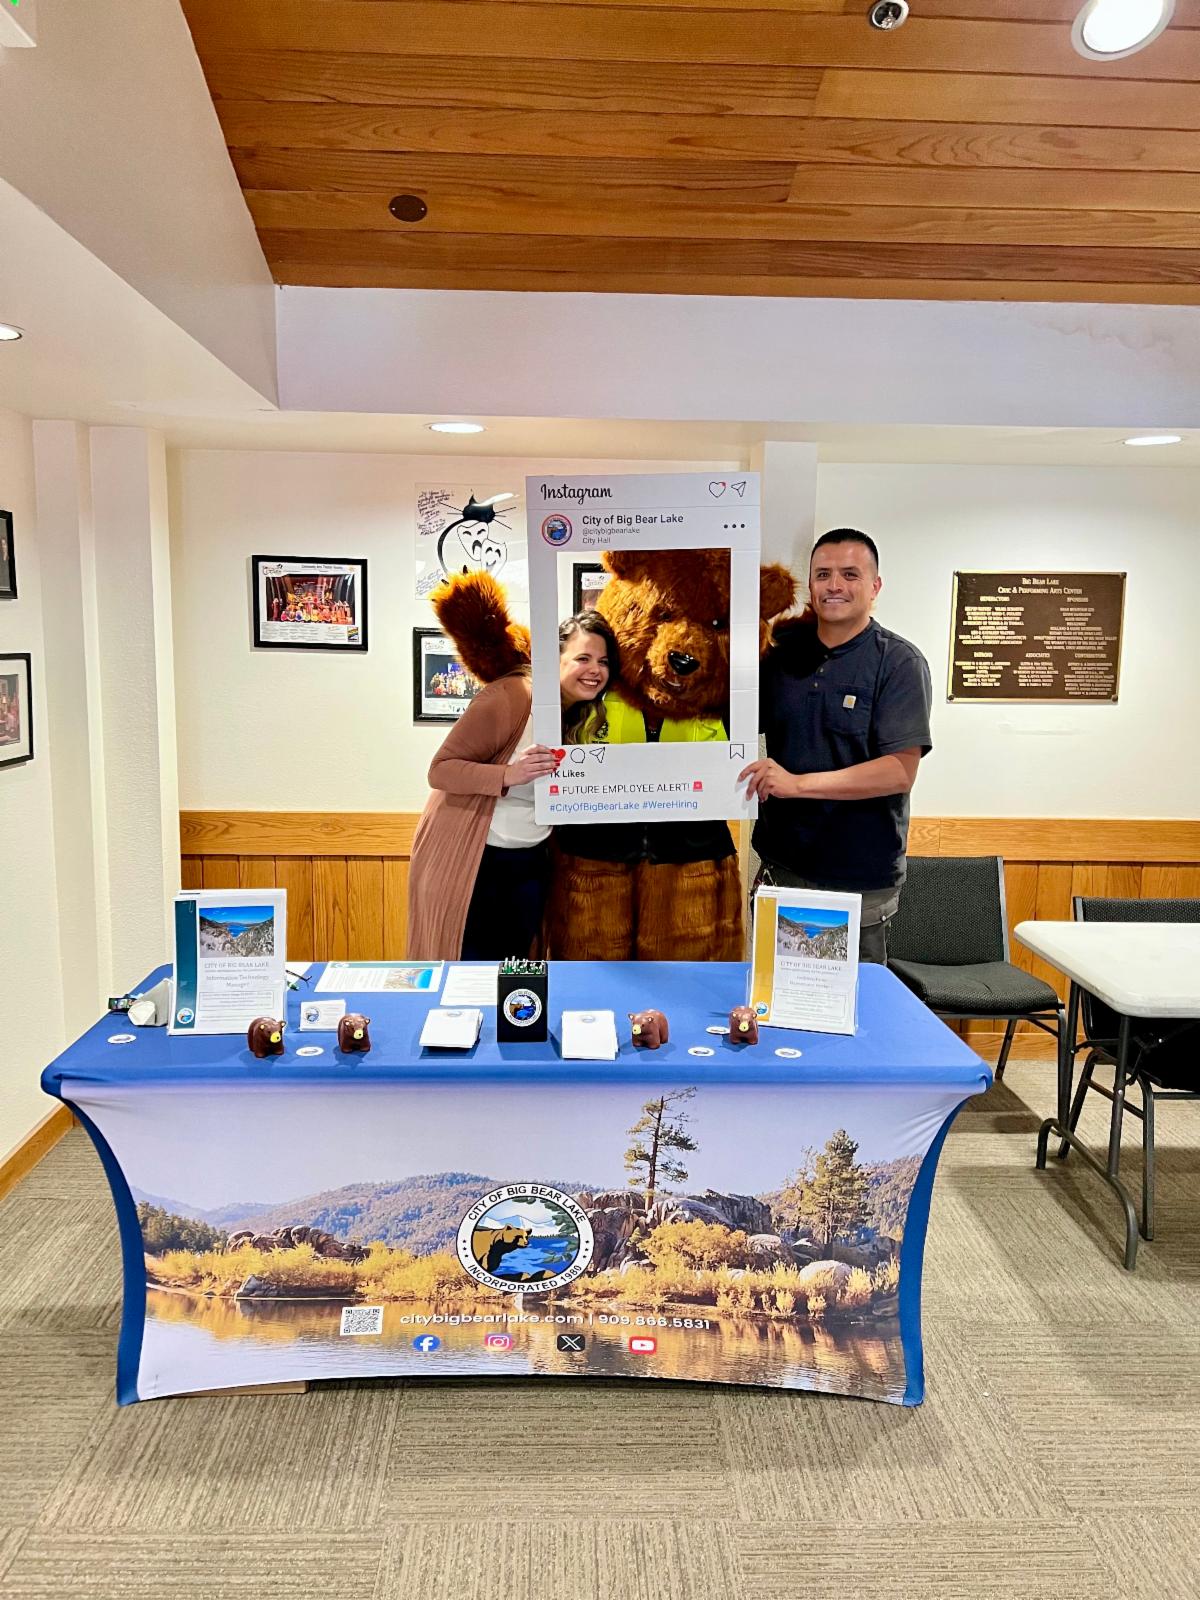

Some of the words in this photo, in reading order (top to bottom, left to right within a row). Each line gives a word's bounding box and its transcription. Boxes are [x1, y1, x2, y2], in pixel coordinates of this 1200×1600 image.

[540, 483, 613, 505] Instagram
[582, 515, 601, 526] City
[604, 515, 615, 525] of
[616, 515, 633, 526] Big
[635, 514, 658, 524] Bear
[660, 514, 684, 523] Lake
[582, 527, 640, 536] @citybigbearlake
[582, 537, 596, 545] City
[597, 536, 611, 544] Hall
[562, 769, 585, 778] Likes
[562, 785, 600, 795] FUTURE
[602, 784, 655, 794] EMPLOYEE
[656, 783, 690, 793] ALERT!
[549, 801, 640, 813] #CityOfBigBearLake
[642, 800, 698, 811] #WereHiring
[468, 1200, 488, 1221] CITY
[488, 1190, 503, 1203] OF
[506, 1185, 527, 1196] BIG
[530, 1186, 562, 1202] BEAR
[562, 1198, 587, 1224] LAKE
[467, 1264, 559, 1292] INCORPORATED
[560, 1264, 582, 1283] 1980
[400, 1313, 584, 1326] citybigbearlake.com
[598, 1314, 710, 1330] 909.866.5831
